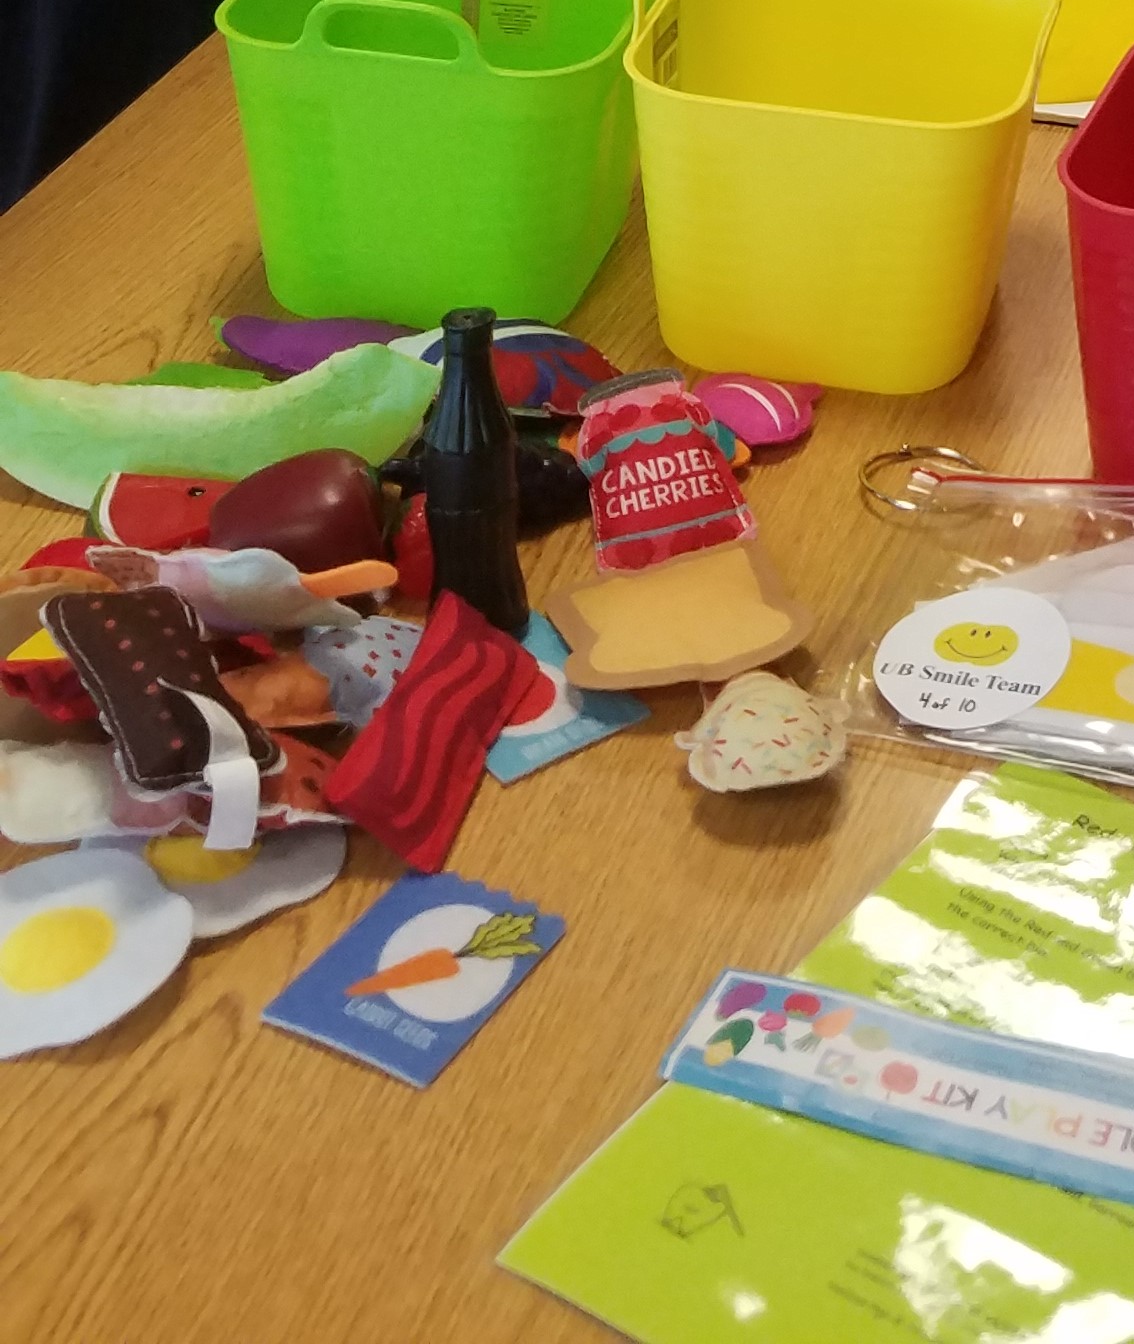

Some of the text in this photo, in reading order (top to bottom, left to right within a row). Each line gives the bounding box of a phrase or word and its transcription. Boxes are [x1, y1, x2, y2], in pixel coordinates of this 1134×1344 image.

[601, 448, 716, 494] CANDIED
[605, 473, 724, 519] CHERRIES
[879, 662, 1042, 696] UB Smile Team
[918, 692, 977, 713] 4 of 10
[919, 1080, 981, 1112] KIT
[983, 1095, 1084, 1139] PLAY
